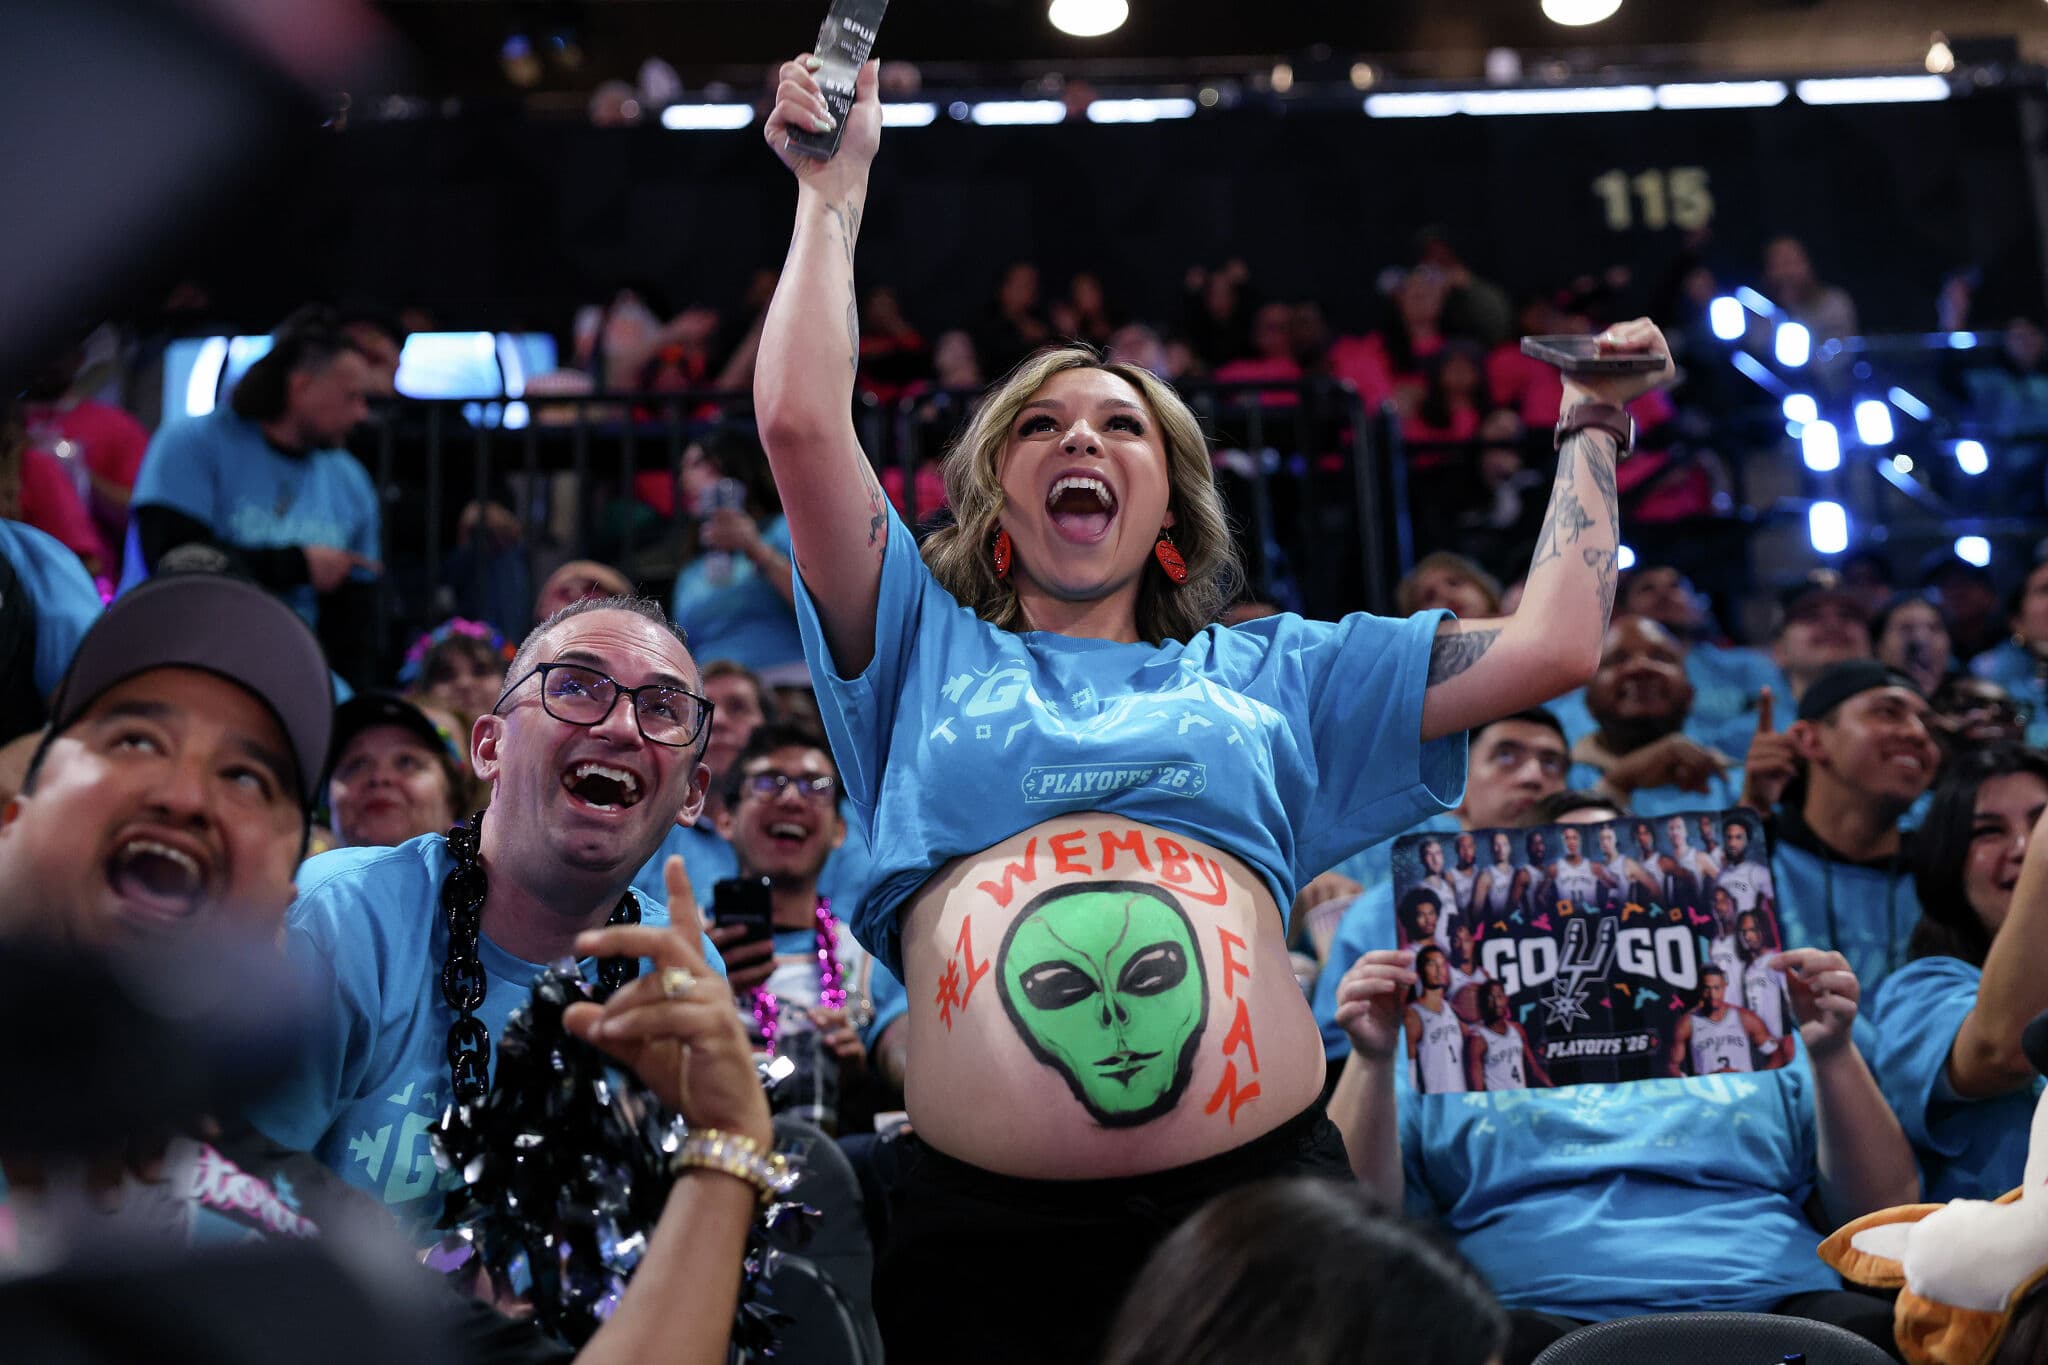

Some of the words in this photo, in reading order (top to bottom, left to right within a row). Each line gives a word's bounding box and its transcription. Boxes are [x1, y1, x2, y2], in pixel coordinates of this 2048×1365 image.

[1592, 167, 1713, 231] 115
[1039, 769, 1153, 795] PLAYOFFS
[1157, 766, 1190, 788] '26
[936, 914, 989, 1032] #1
[976, 829, 1228, 908] WEMBY
[1204, 925, 1262, 1127] FAN
[1481, 936, 1558, 996] GO
[1615, 924, 1699, 991] GO
[1546, 1038, 1621, 1059] PLAYOFFS
[1623, 1034, 1650, 1052] '26
